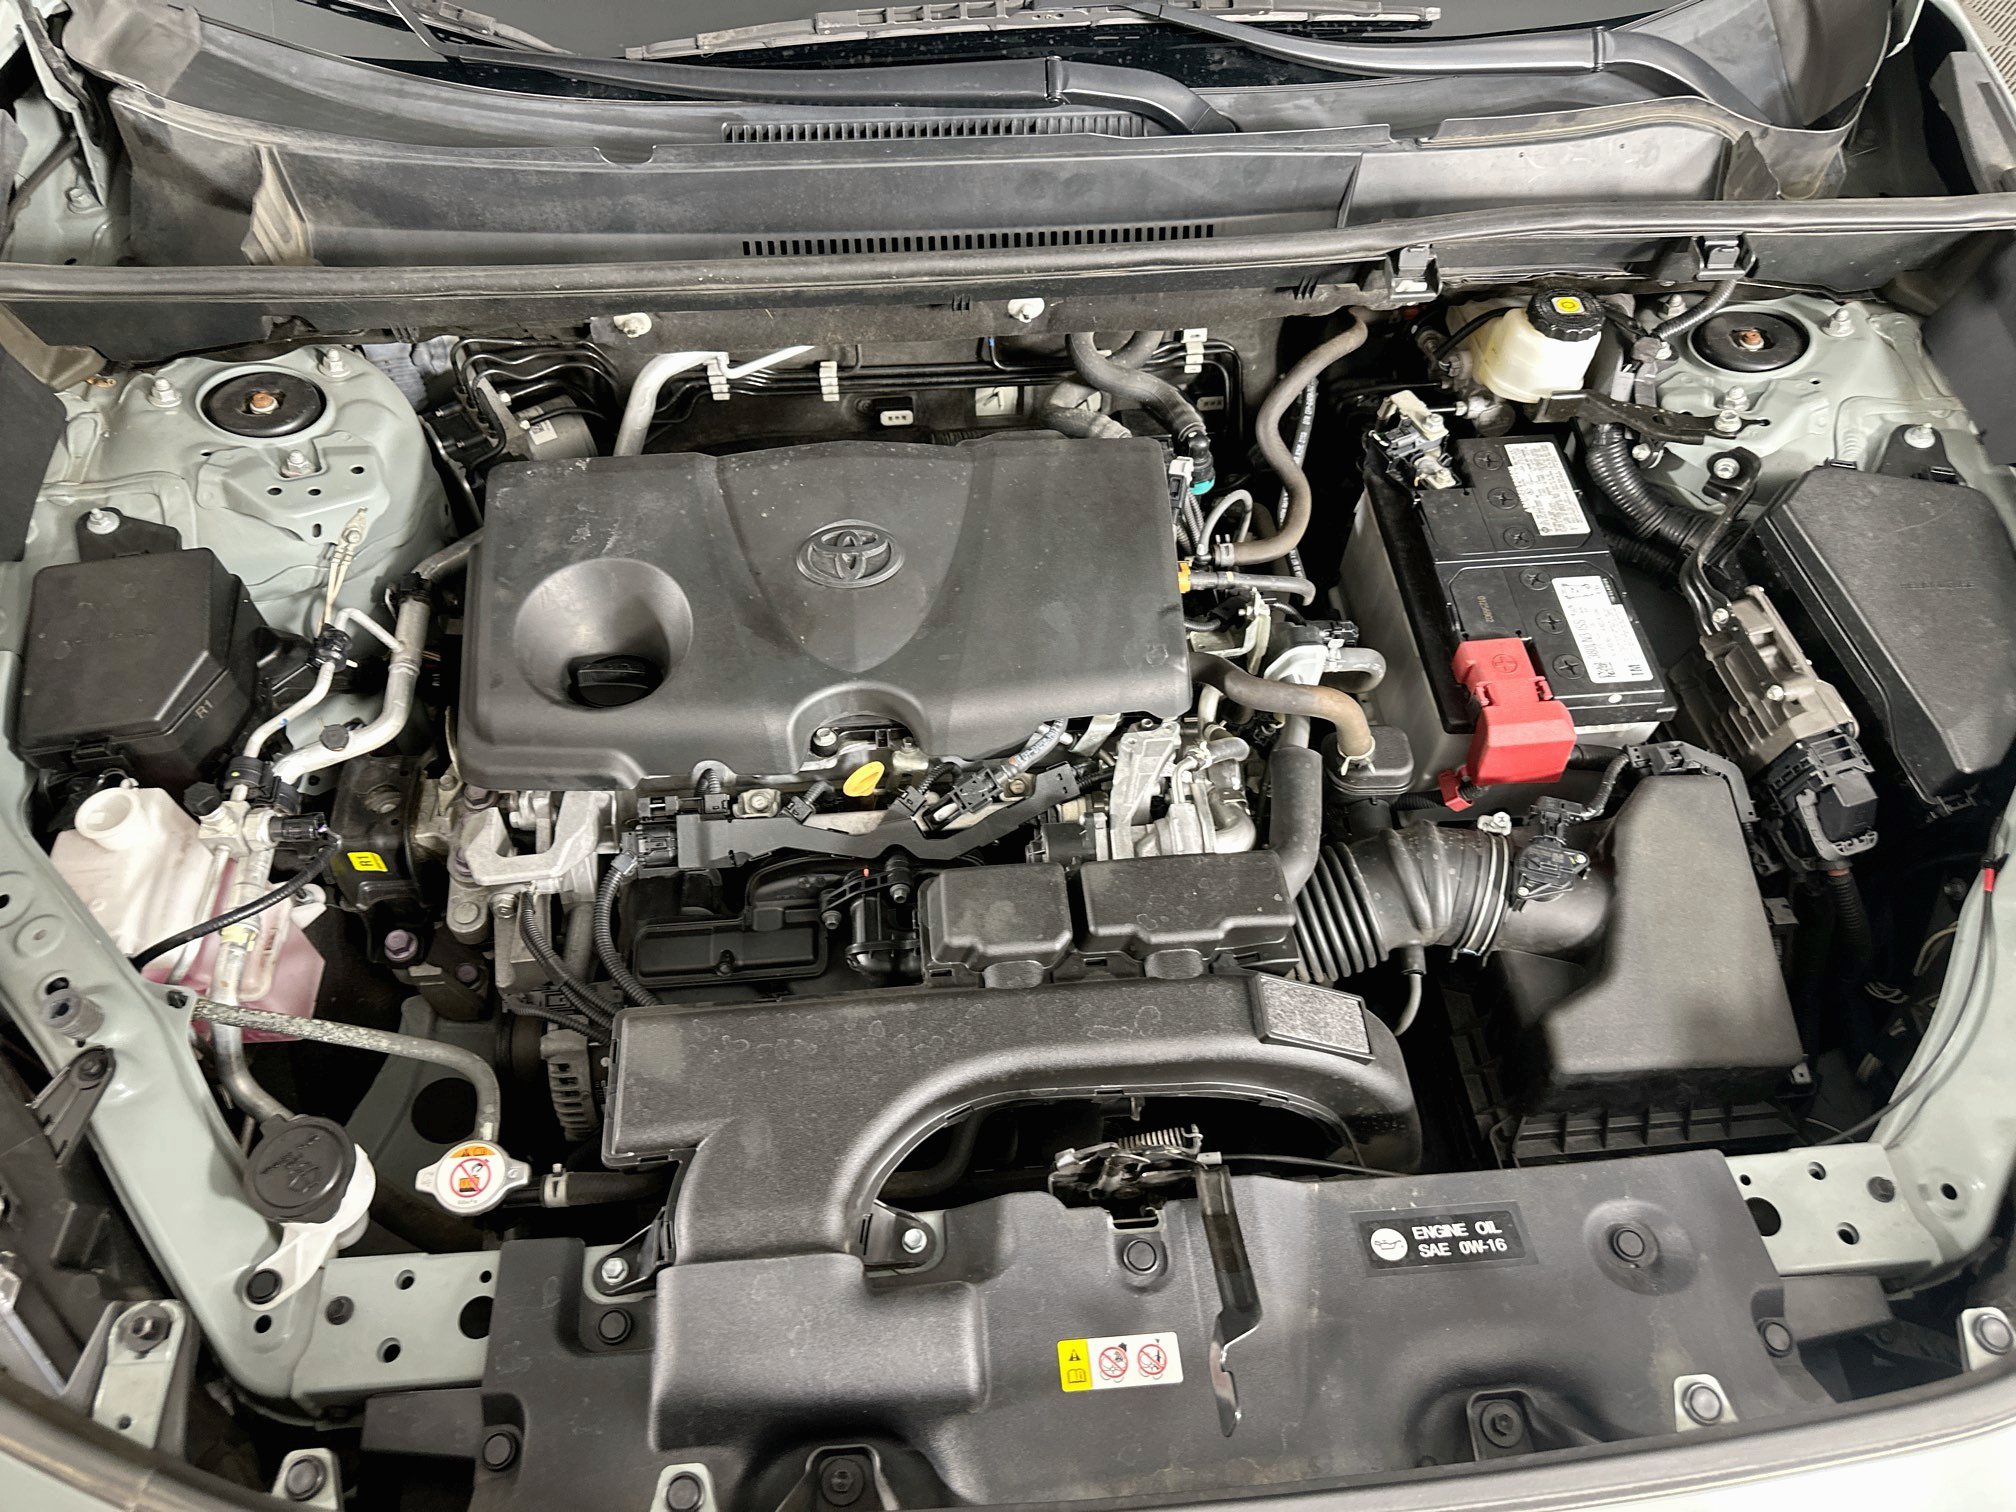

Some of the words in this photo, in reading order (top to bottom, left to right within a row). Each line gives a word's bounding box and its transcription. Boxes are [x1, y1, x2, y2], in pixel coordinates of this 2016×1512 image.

[1411, 1223, 1469, 1240] ENGINE
[1474, 1220, 1503, 1236] OIL
[1417, 1242, 1452, 1258] SAE
[1458, 1237, 1508, 1255] 0W-16
